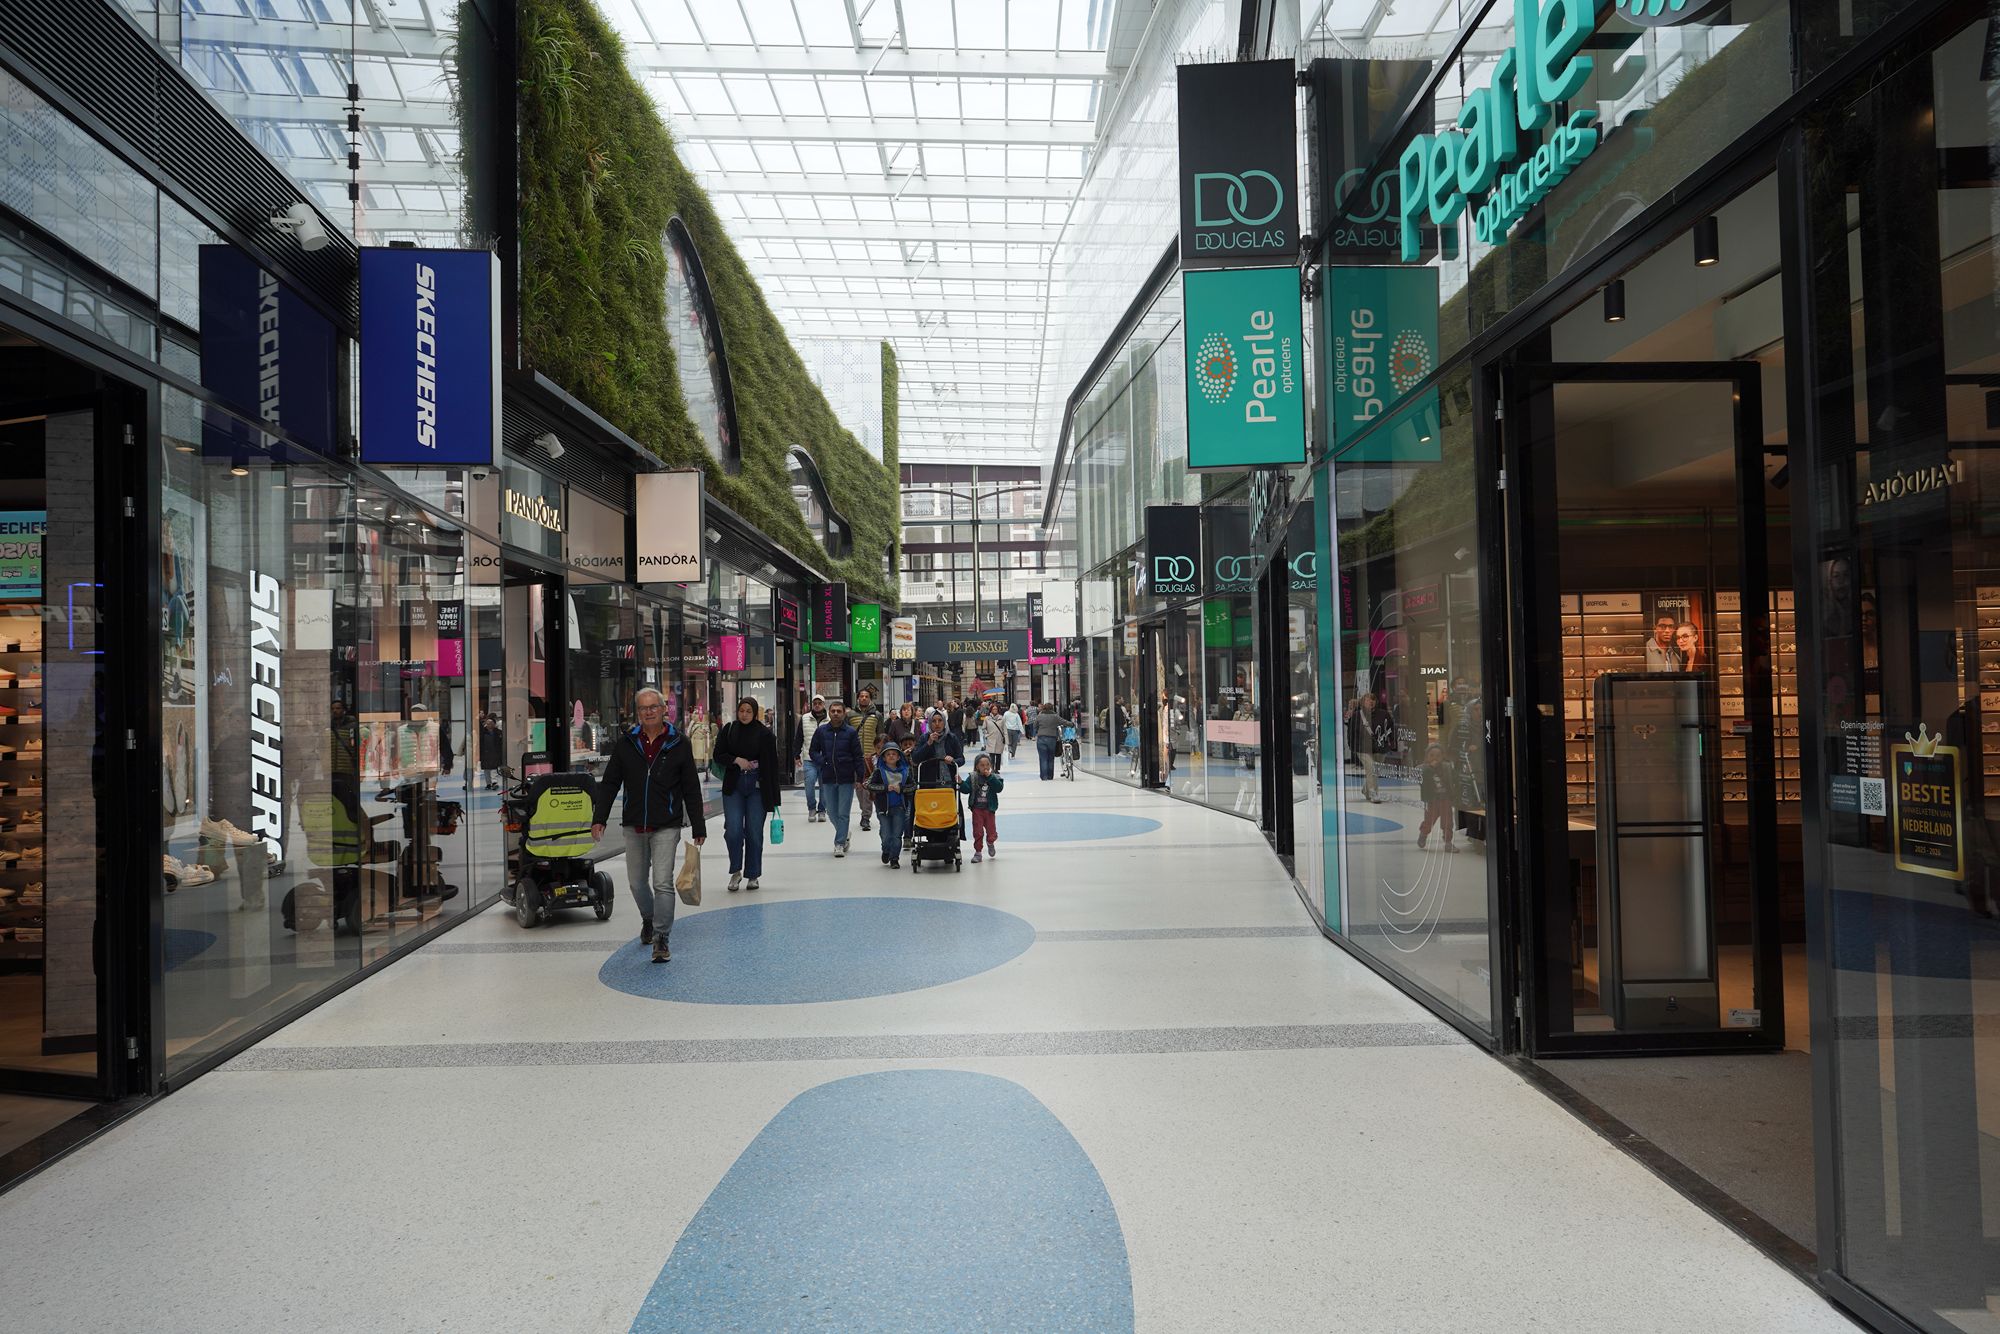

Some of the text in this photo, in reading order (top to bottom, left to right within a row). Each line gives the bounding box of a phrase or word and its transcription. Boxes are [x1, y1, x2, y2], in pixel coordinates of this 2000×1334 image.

[1476, 109, 1597, 245] opticiens
[1195, 230, 1285, 250] DOUGLAS
[416, 262, 437, 449] SKECHERS
[1243, 309, 1277, 423] Pearle
[1280, 336, 1295, 393] opticiens
[505, 489, 562, 532] PANDORA
[639, 553, 698, 566] PANDORA
[1155, 583, 1196, 593] DOUGLAS
[824, 600, 833, 625] PARIS
[949, 639, 1008, 653] DE PASSAGE
[1840, 720, 1884, 731] Openingstijden
[1901, 782, 1952, 805] BESTE
[1903, 818, 1953, 837] NEDERLAND
